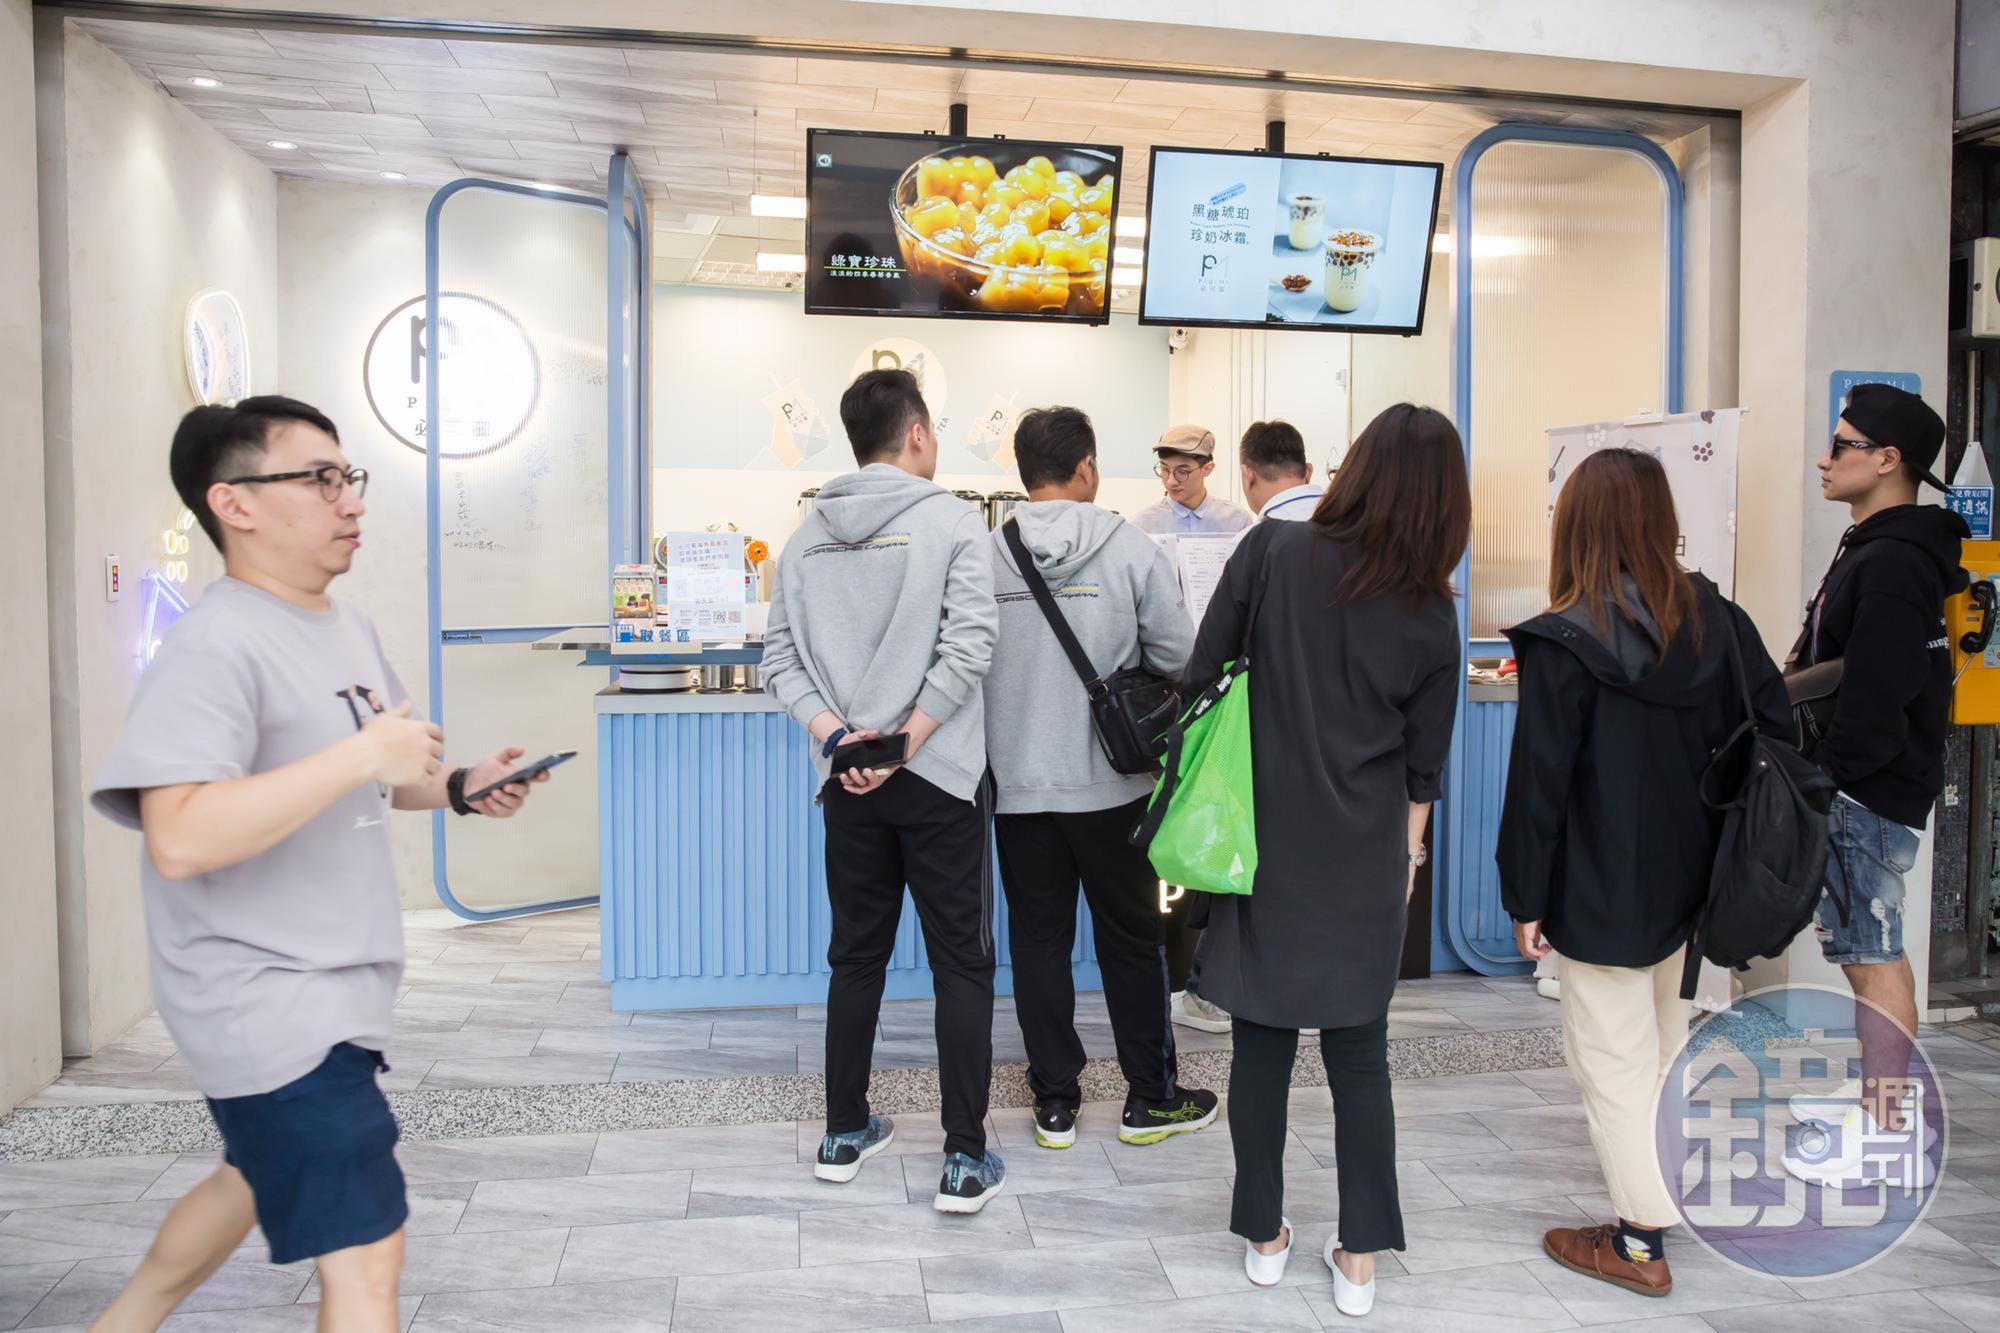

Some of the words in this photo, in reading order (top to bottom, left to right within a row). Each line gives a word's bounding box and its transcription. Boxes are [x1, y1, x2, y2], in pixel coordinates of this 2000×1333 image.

[1192, 204, 1249, 221] 黑糖琥珀
[1190, 228, 1247, 244] 珍奶冰霜
[831, 254, 896, 268] 綠寶珍珠
[640, 629, 690, 642] 取餐區
